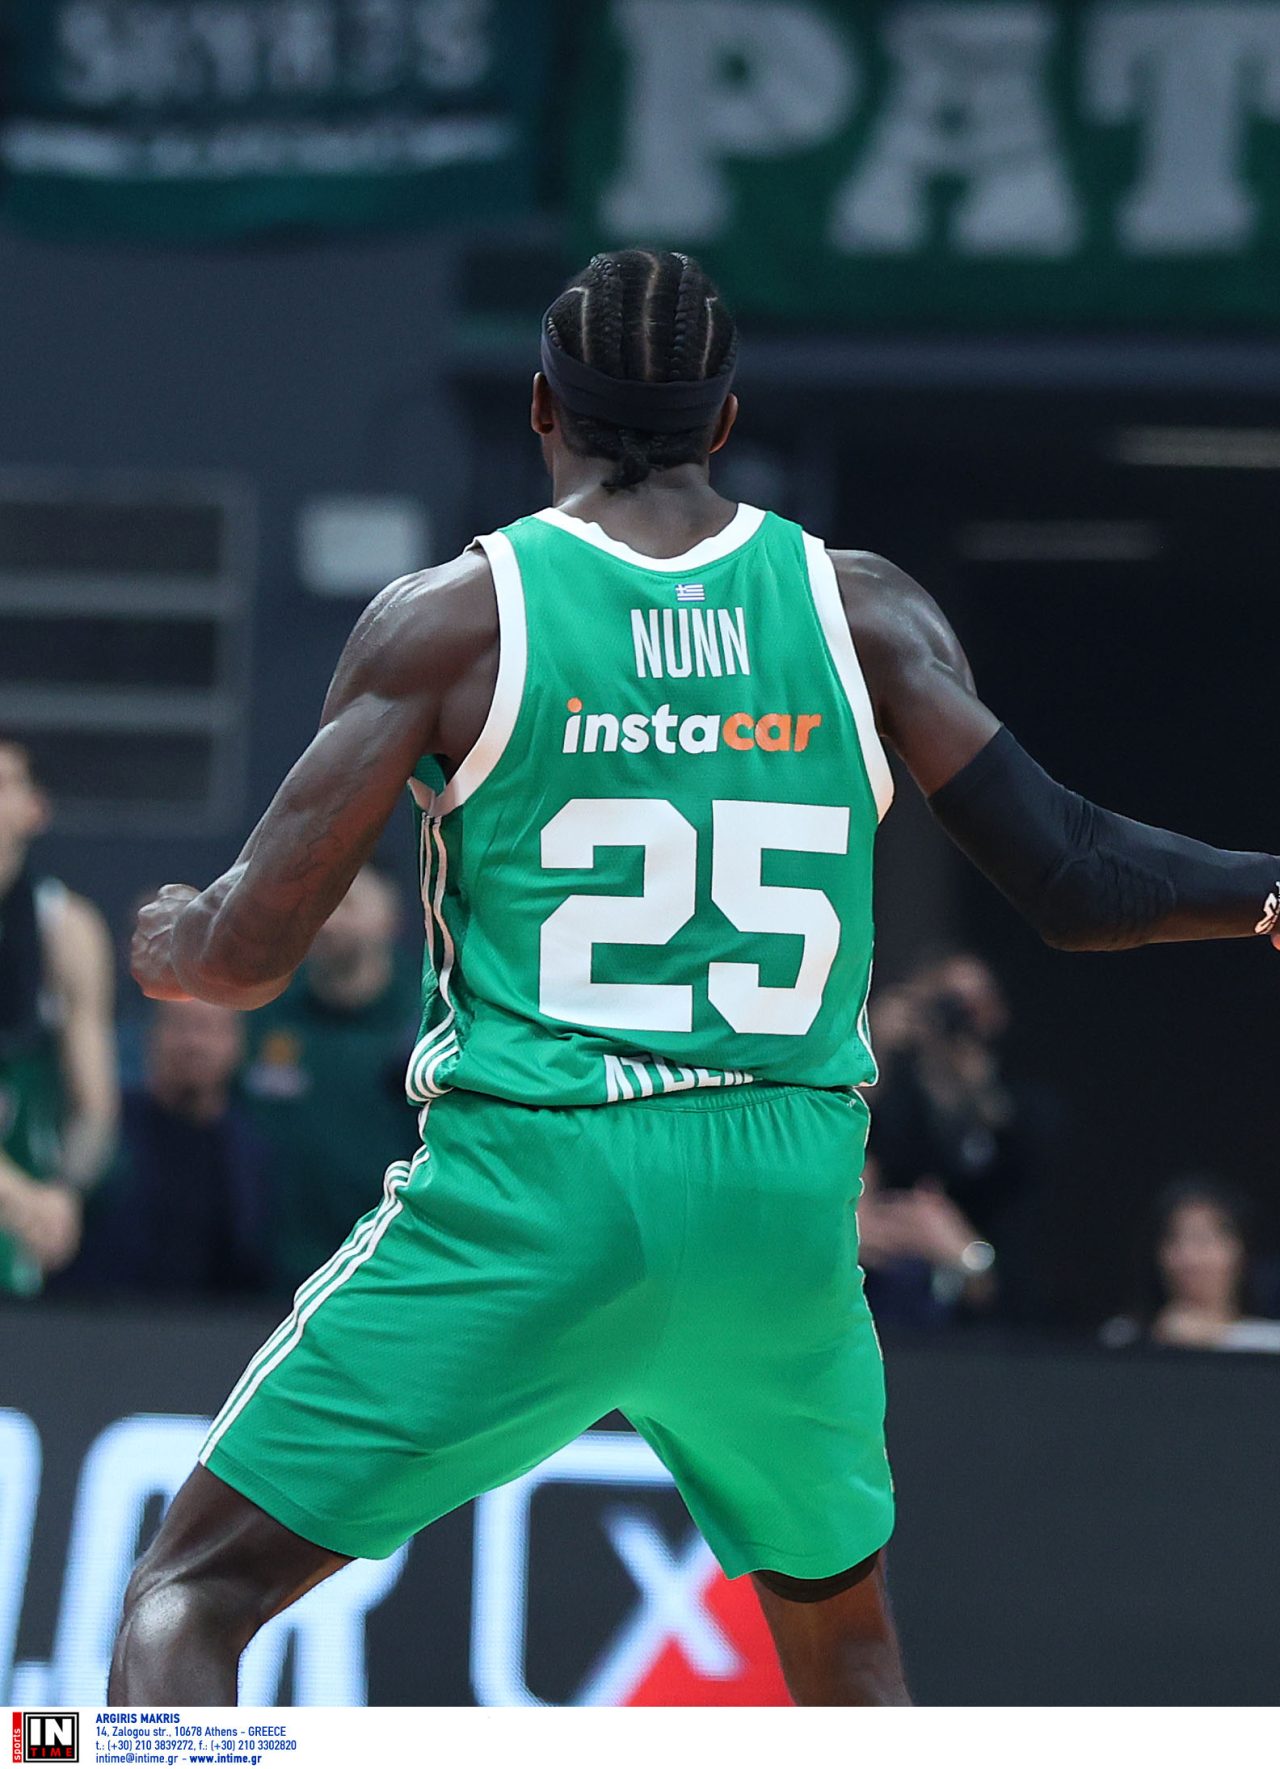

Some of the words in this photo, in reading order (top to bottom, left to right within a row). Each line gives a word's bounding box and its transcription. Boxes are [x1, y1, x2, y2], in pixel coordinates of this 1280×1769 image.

[631, 607, 751, 679] NUNN
[562, 697, 822, 754] instacar
[538, 798, 851, 1036] 25
